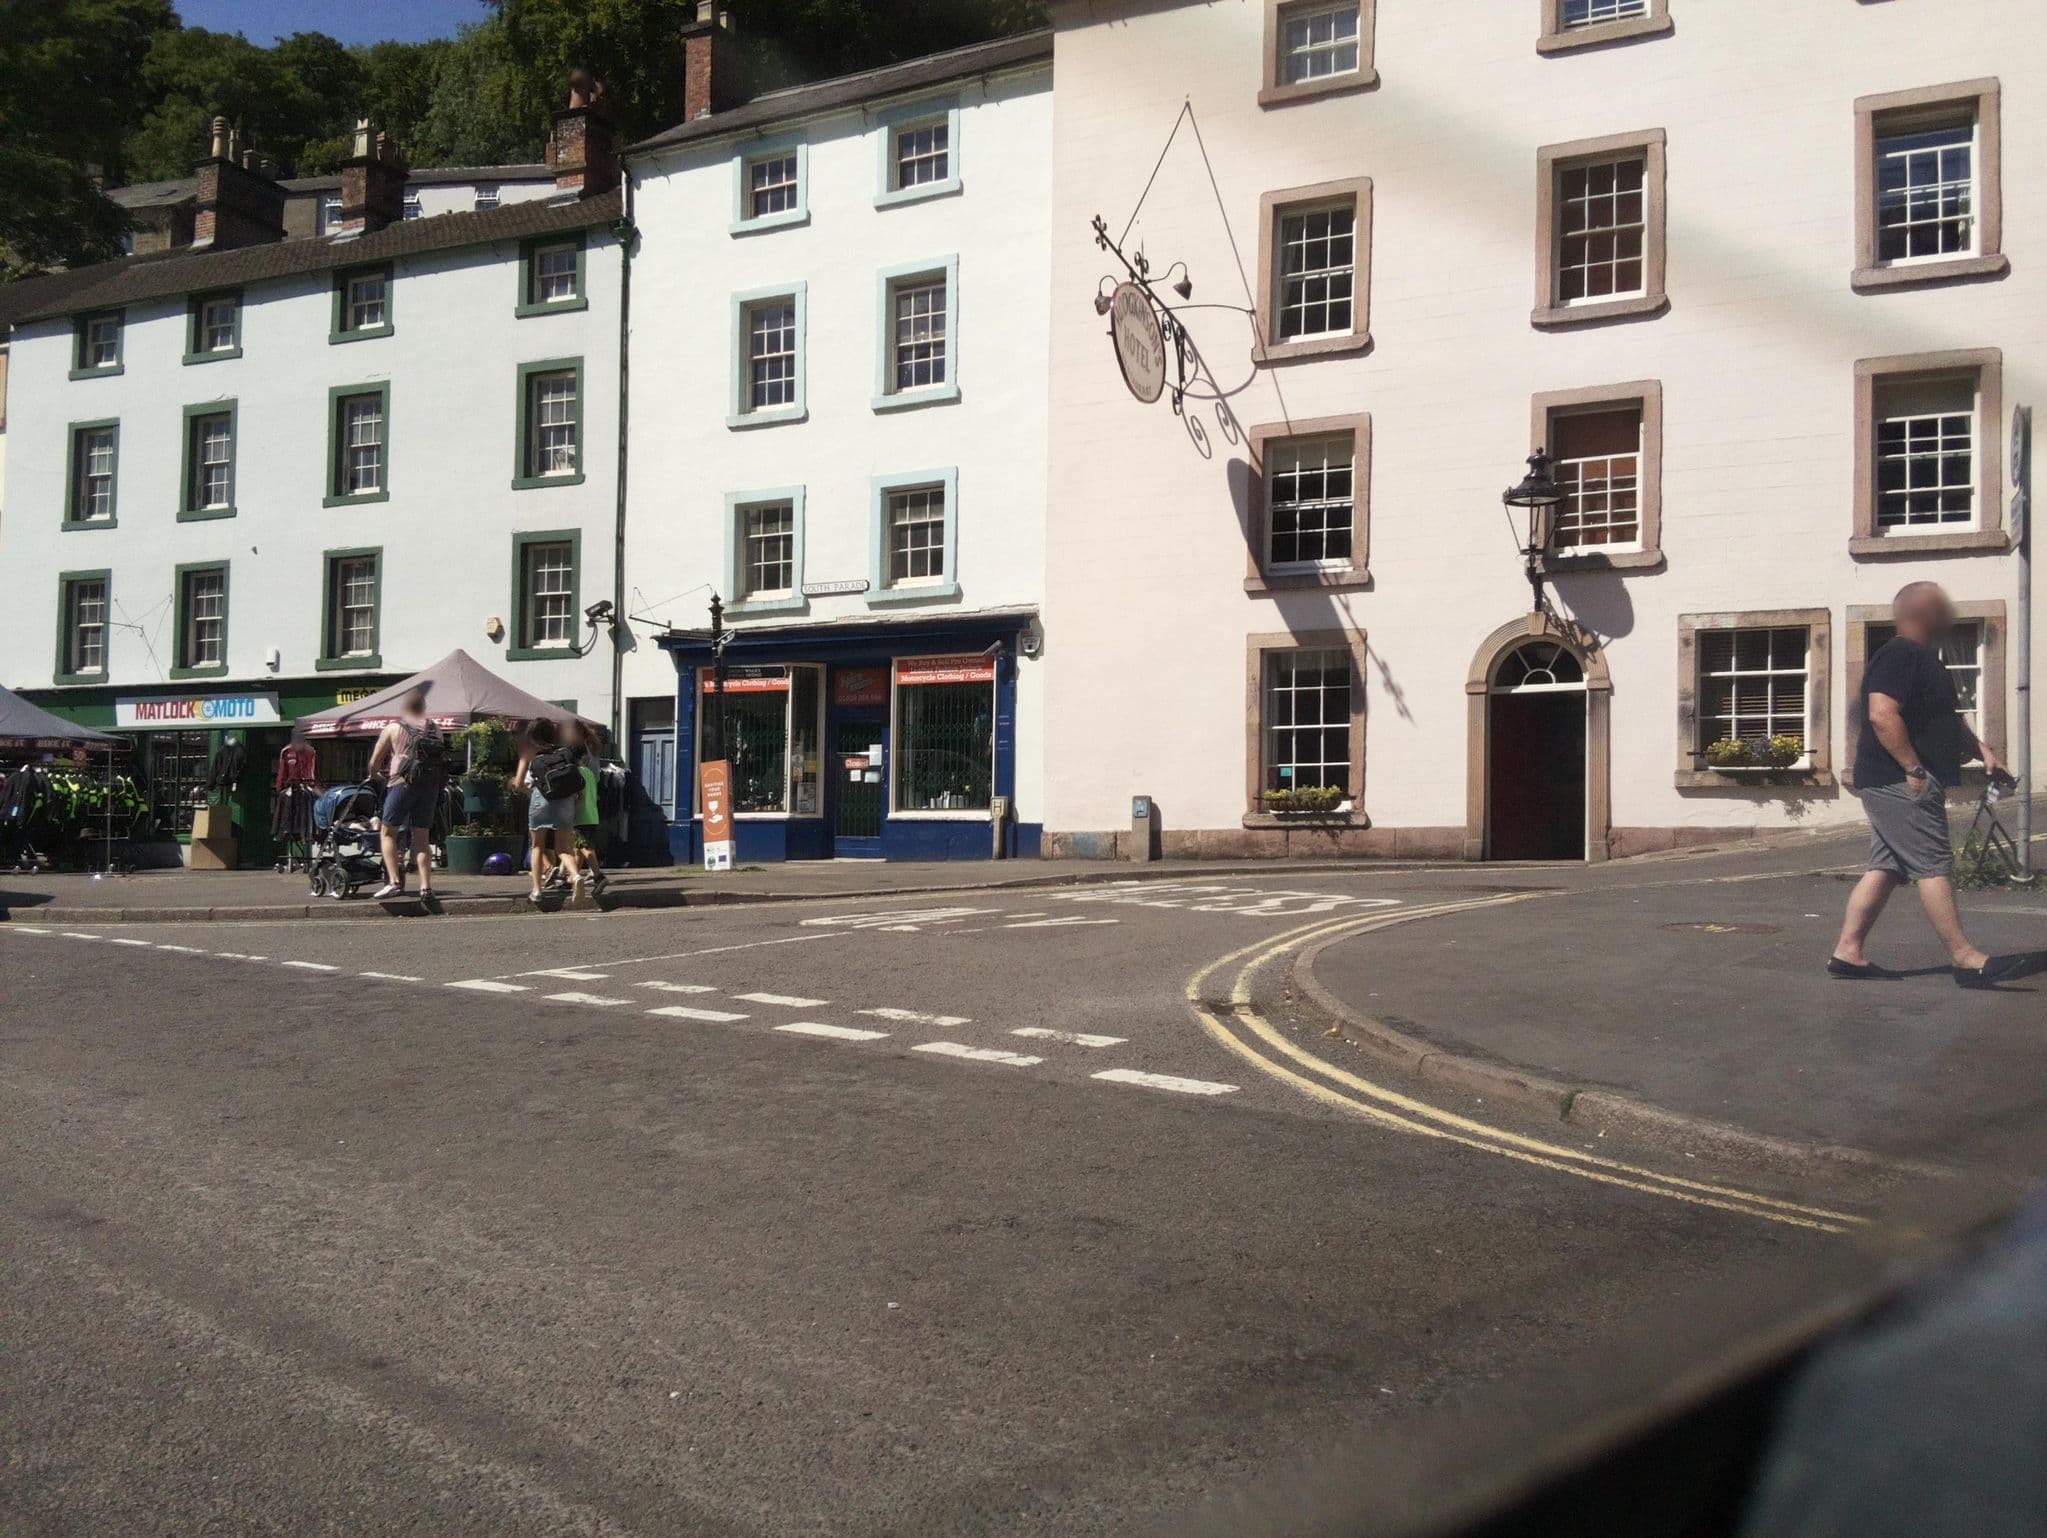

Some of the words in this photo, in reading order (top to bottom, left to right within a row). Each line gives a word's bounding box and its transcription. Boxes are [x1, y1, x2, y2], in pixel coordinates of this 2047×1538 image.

[1124, 324, 1151, 375] HOTEL
[803, 584, 831, 594] SOUTH
[834, 581, 866, 592] PARADE
[900, 674, 936, 683] Motorcycle
[937, 673, 964, 682] Clothing
[970, 671, 992, 680] Goods
[742, 679, 767, 688] Clothing
[135, 699, 196, 720] MATLOCK
[214, 696, 256, 718] MOTO
[361, 719, 388, 731] BIKE
[845, 757, 868, 769] Closed
[993, 800, 1003, 814] H
